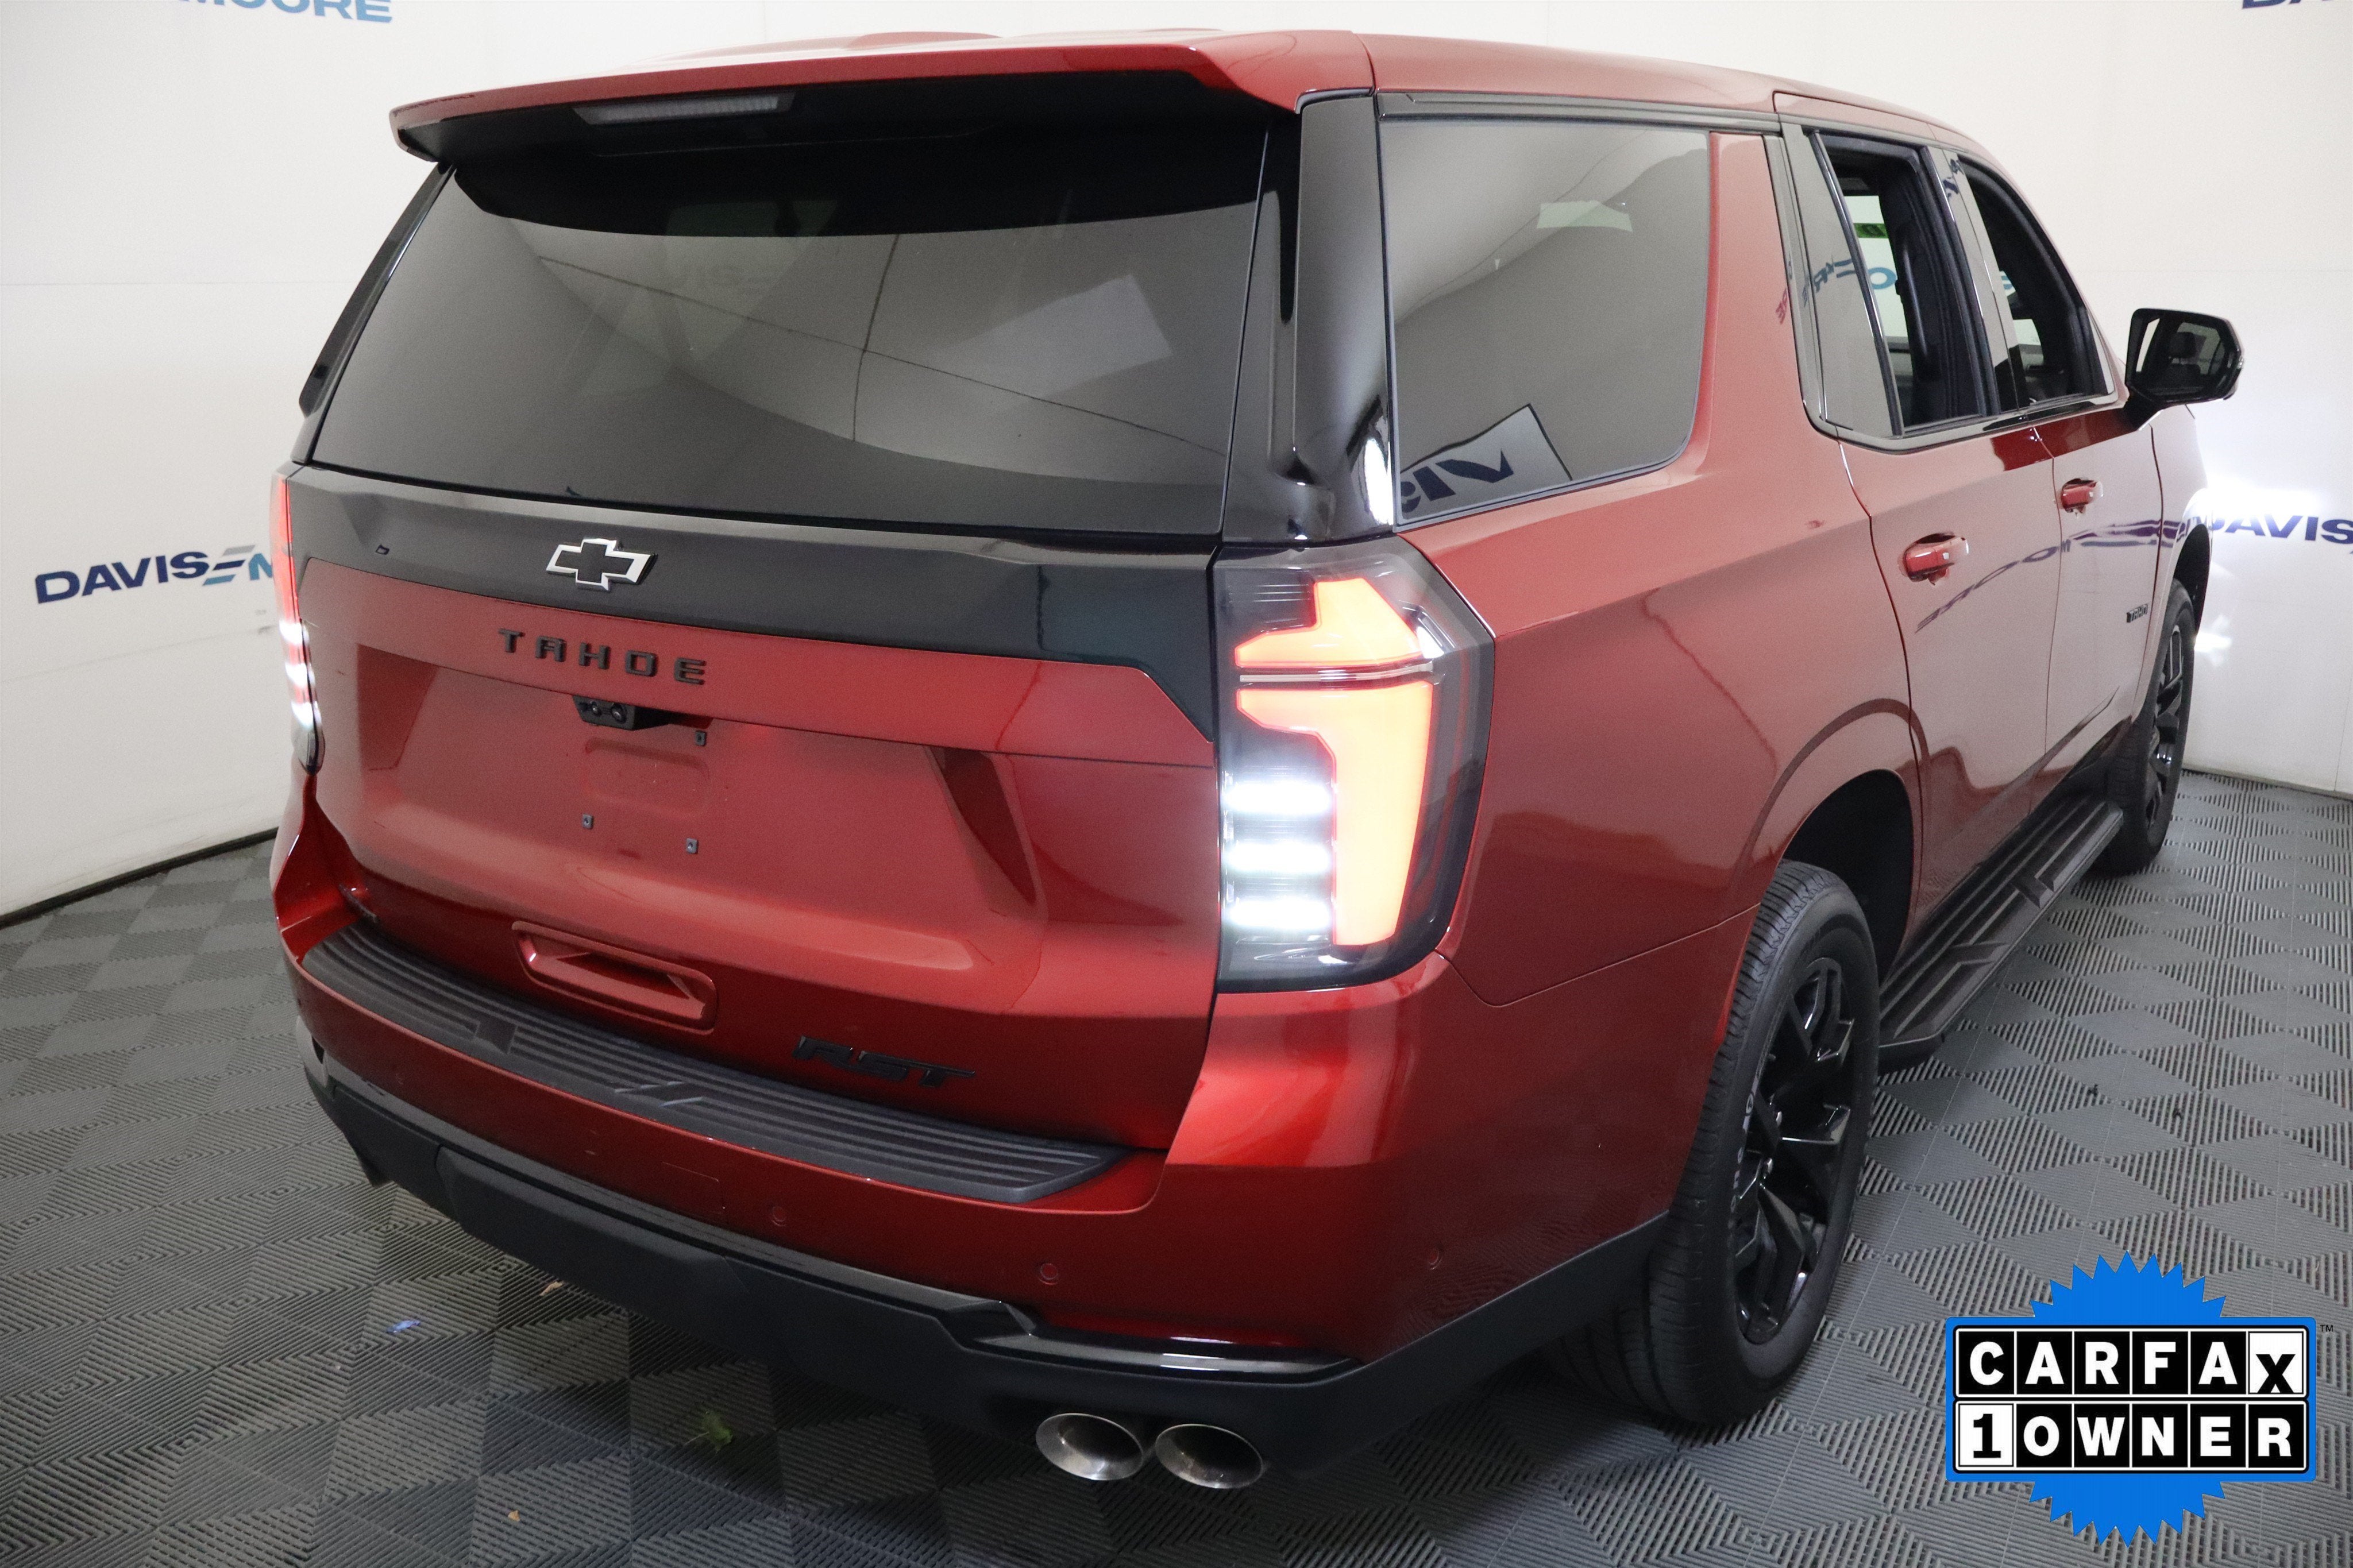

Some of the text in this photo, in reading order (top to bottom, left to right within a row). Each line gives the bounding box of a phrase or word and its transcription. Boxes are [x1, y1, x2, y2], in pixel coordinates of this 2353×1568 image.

[2212, 513, 2353, 544] AVIS
[35, 551, 209, 604] DAVIS
[498, 628, 707, 685] TAHOE
[792, 1036, 976, 1088] RST
